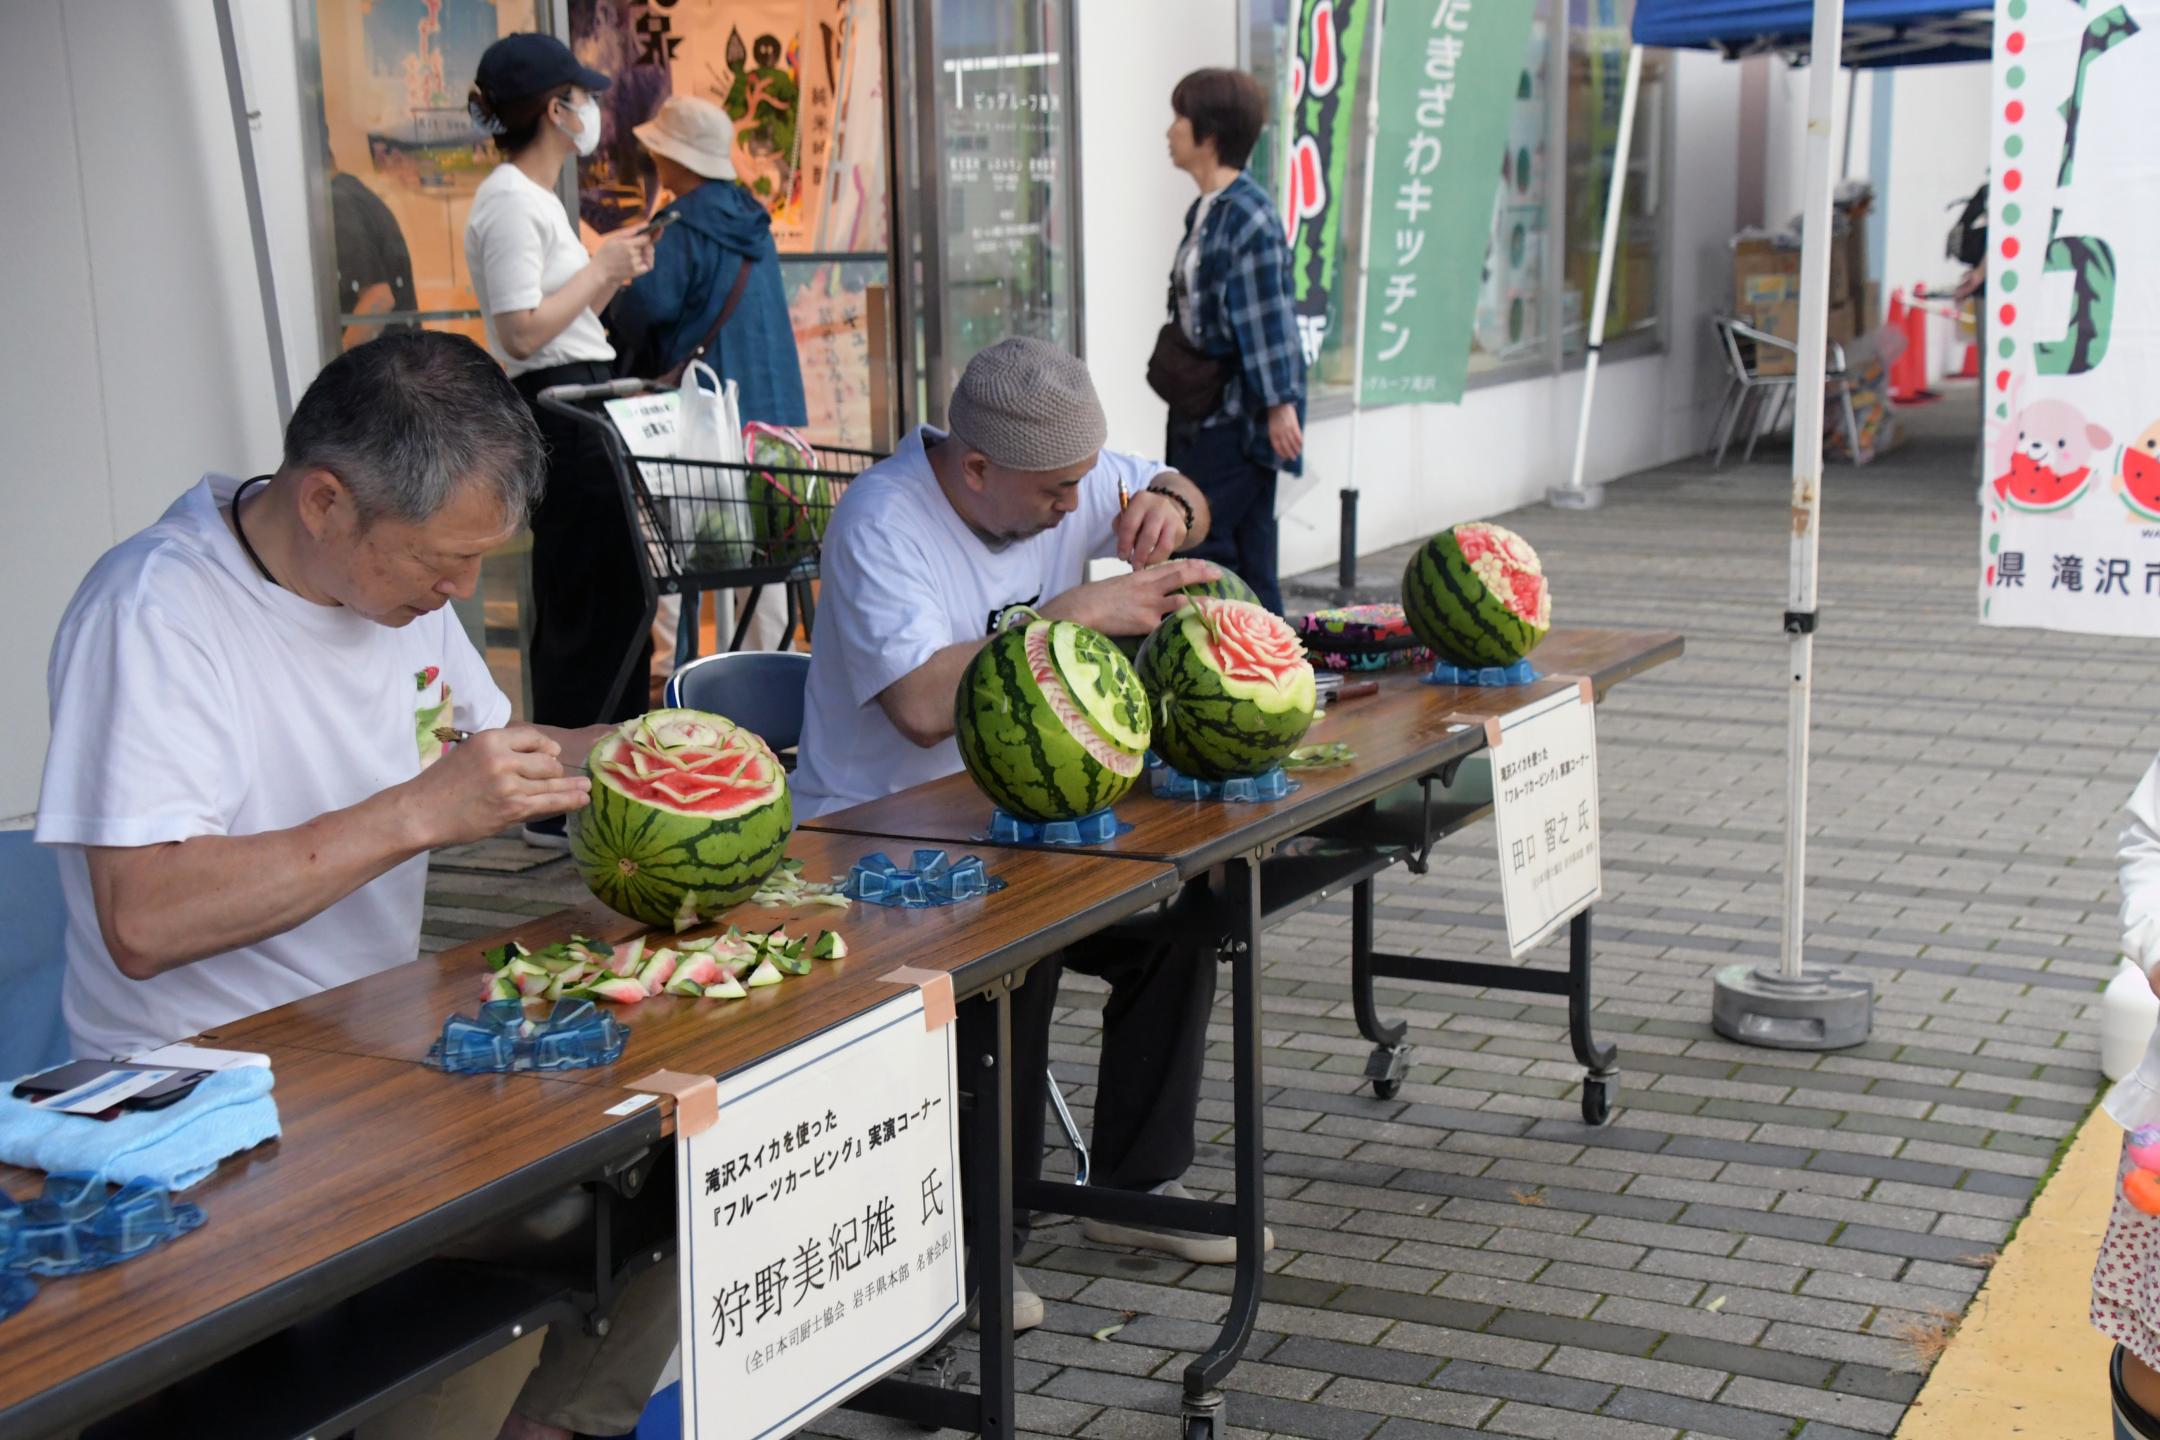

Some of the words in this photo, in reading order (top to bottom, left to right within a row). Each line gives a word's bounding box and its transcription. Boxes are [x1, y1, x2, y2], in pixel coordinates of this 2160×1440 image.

[1377, 0, 1470, 361] たきざわキッチン
[1512, 834, 1536, 875] 田口
[1578, 799, 1590, 833] 氏
[704, 1108, 838, 1197] 滝沢スイカを使った
[711, 1195, 897, 1348] 狩野美紀雄
[921, 1167, 944, 1227] 氏
[852, 1262, 910, 1310] 岩手県本部
